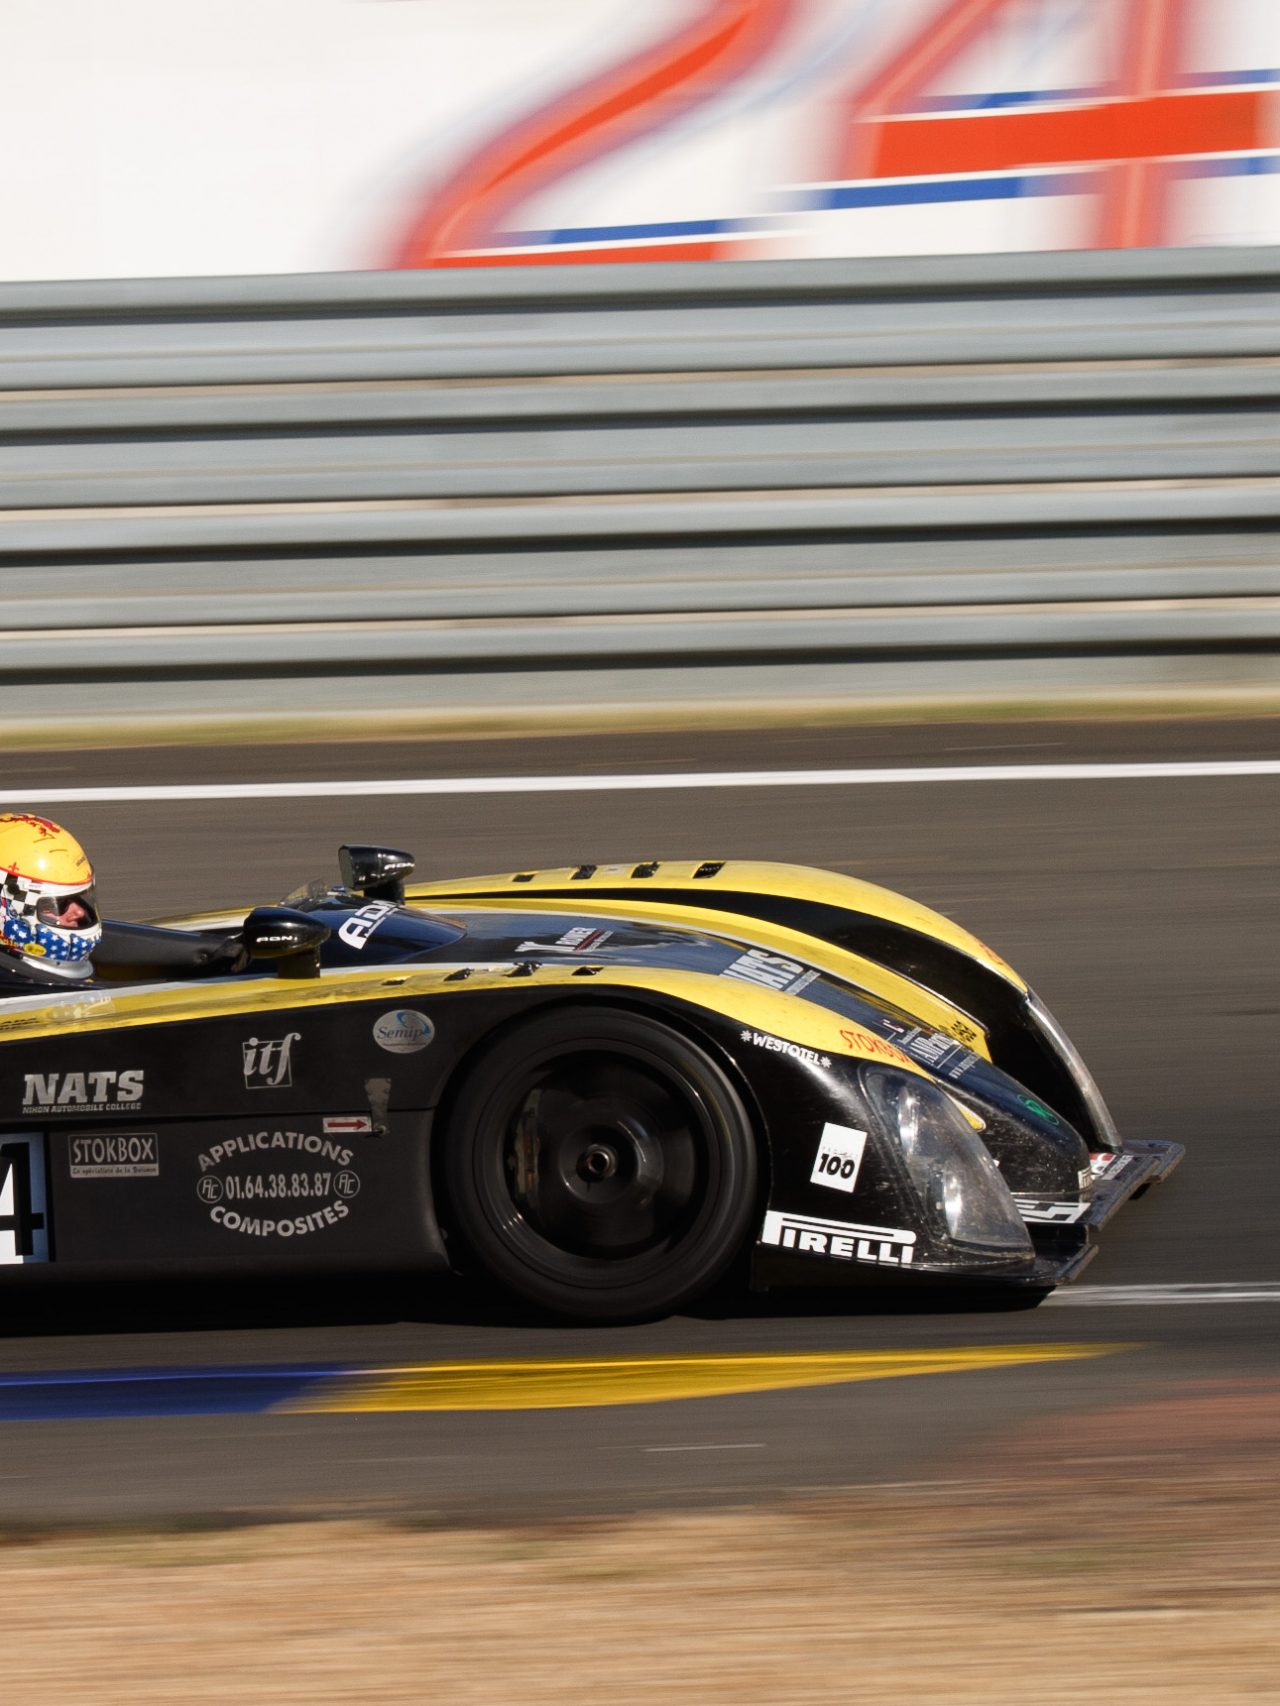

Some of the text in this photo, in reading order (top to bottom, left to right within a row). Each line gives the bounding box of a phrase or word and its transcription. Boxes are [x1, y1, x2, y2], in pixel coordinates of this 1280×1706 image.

[243, 1033, 301, 1085] itf
[752, 1032, 821, 1065] WESTOTEL
[22, 1070, 144, 1105] NATS
[73, 1137, 154, 1163] STOKBOX
[197, 1131, 354, 1172] APPLICATIONS
[818, 1153, 855, 1179] 100
[225, 1173, 331, 1200] 01.64.38.83.87
[210, 1200, 349, 1237] COMPOSITES
[761, 1210, 917, 1264] PIRELLI
